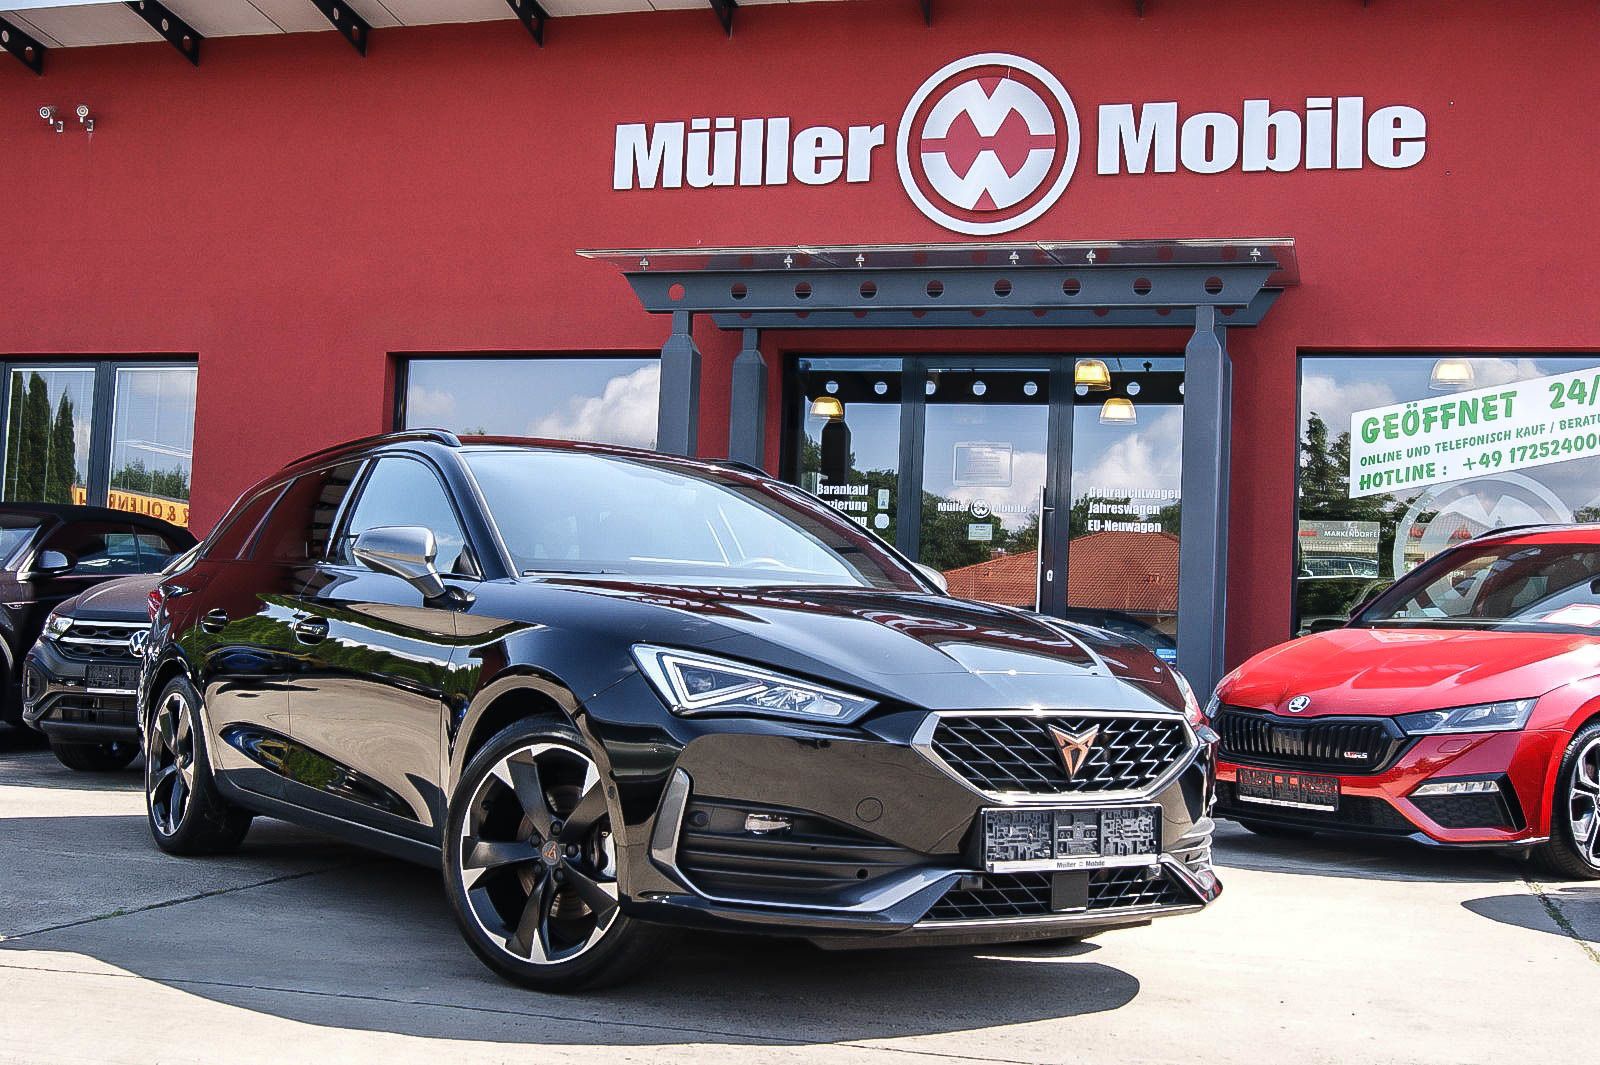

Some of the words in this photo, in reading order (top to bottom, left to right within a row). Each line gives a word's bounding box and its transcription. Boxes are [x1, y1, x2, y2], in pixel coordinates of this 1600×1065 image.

[613, 116, 885, 190] Müller
[1097, 96, 1427, 175] Mobile
[1361, 390, 1518, 444] GEÖFFNET
[1549, 374, 1600, 410] 24/
[1359, 462, 1436, 491] HOTLINE
[1462, 450, 1503, 471] +49
[1509, 433, 1600, 464] 17252400
[1360, 450, 1402, 467] ONLINE
[1406, 444, 1431, 458] UND
[1435, 429, 1511, 453] TELEFONISCH
[1515, 423, 1546, 439] KAUF
[817, 483, 869, 496] Barankauf
[1088, 501, 1161, 515] Jahreswagen
[1087, 519, 1162, 533] EU-Neuwagen
